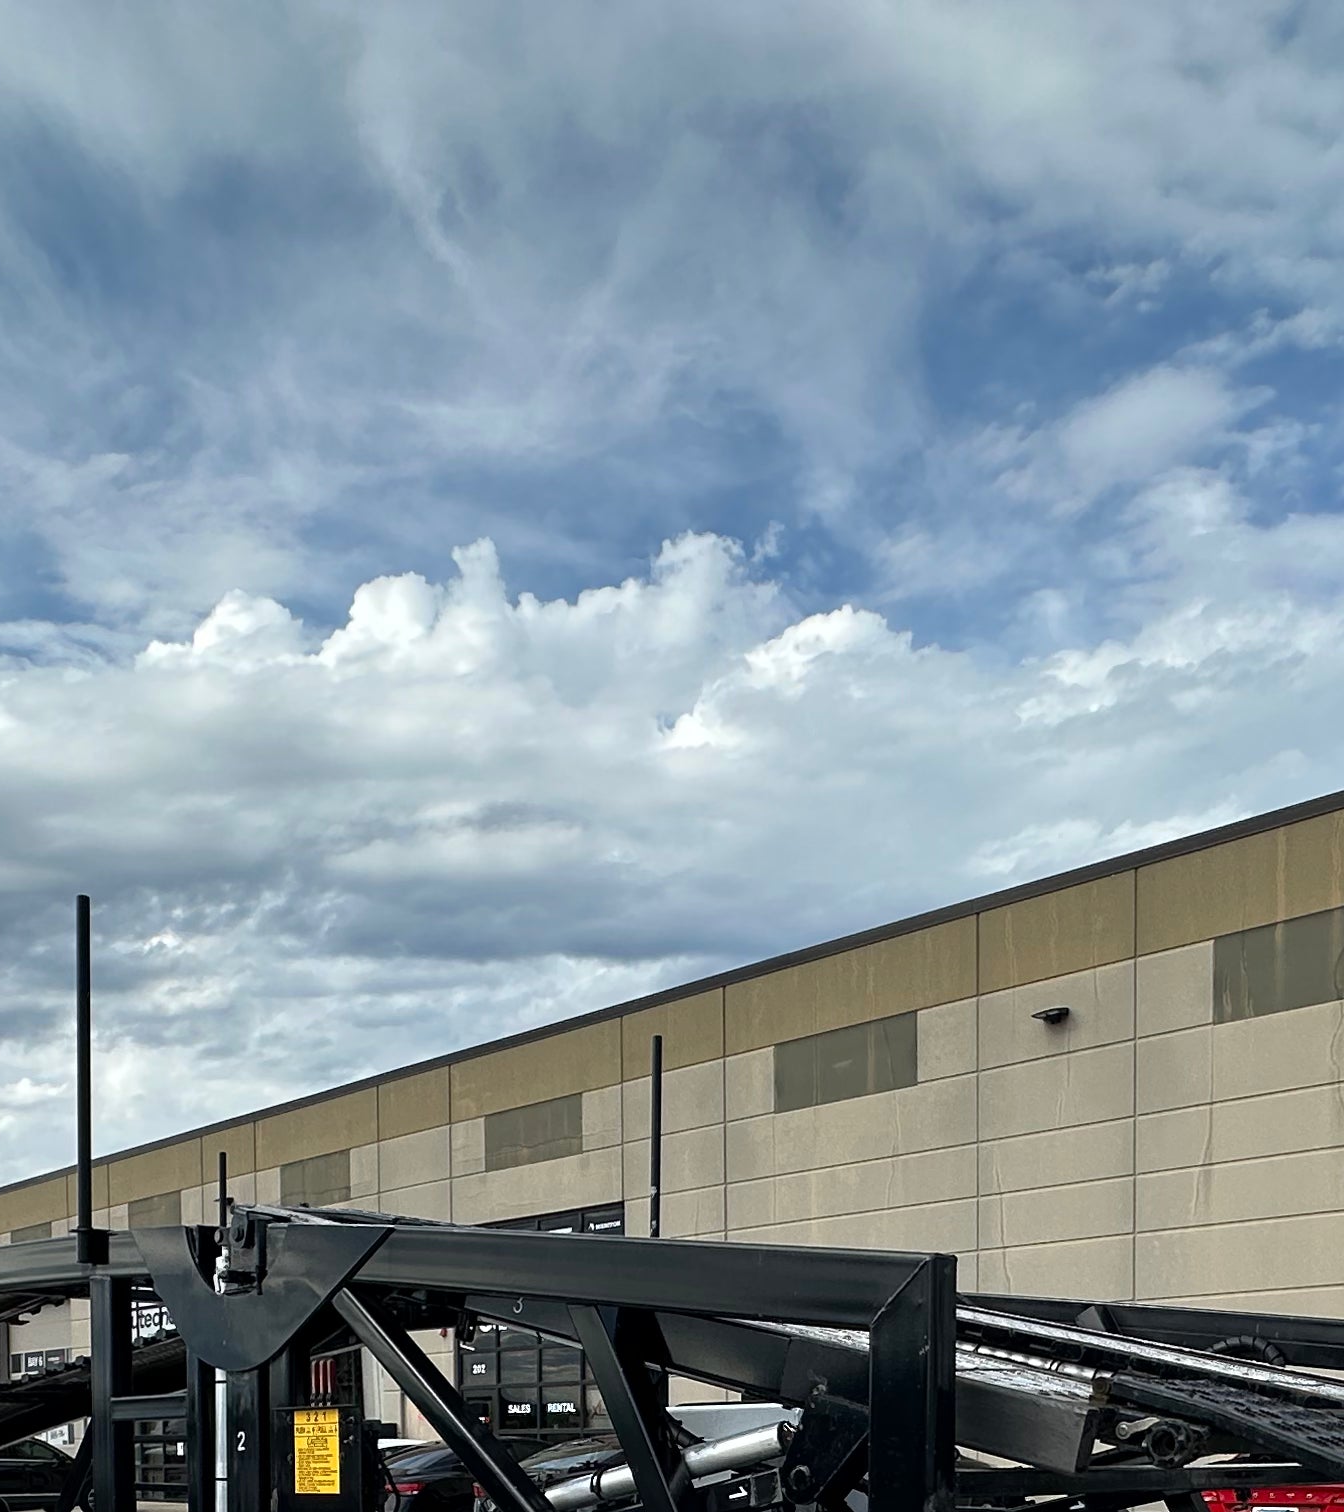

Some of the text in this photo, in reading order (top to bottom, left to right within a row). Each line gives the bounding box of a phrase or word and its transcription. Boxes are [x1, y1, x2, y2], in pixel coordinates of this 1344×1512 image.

[507, 1402, 576, 1414] SALES RENTAL
[237, 1431, 246, 1451] 2
